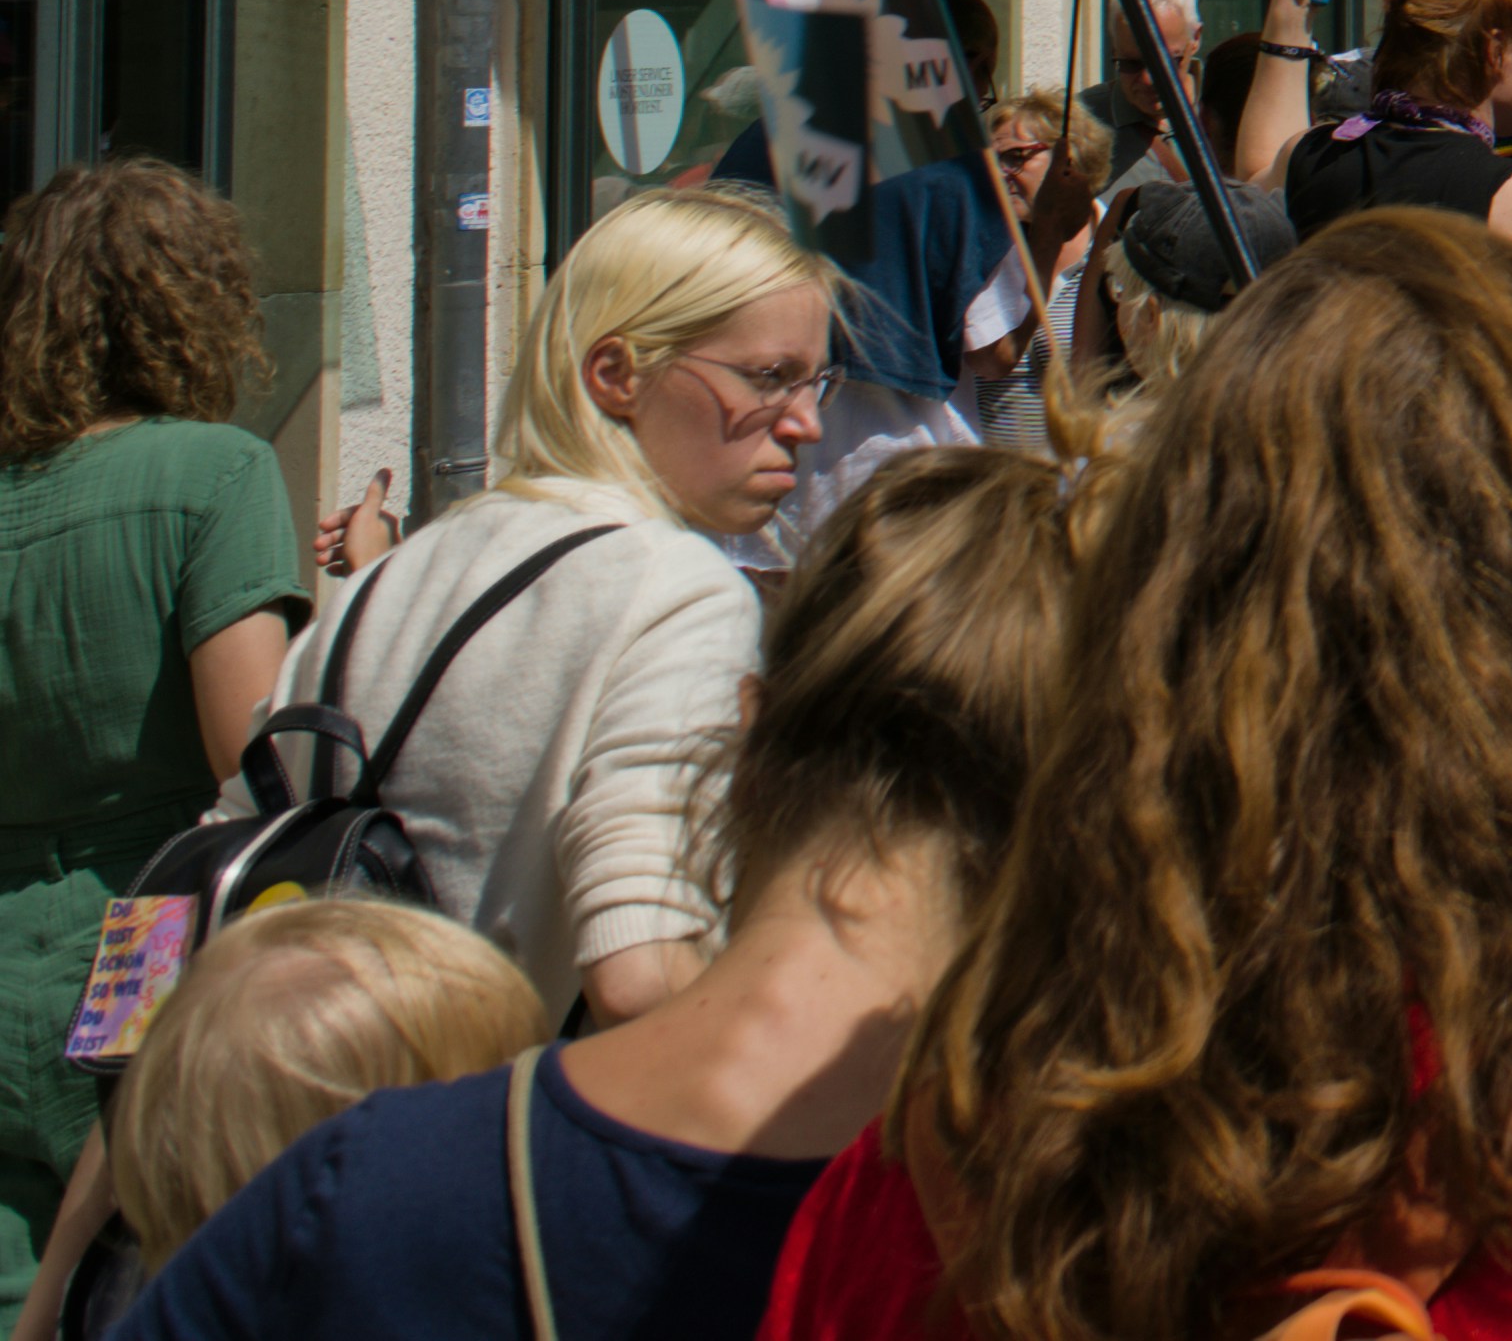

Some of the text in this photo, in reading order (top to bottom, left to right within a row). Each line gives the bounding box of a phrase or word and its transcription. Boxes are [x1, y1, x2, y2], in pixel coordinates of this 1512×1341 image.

[109, 900, 134, 919] DU
[104, 926, 137, 945] BIST
[89, 981, 110, 1001] SO
[113, 978, 144, 998] WIE
[79, 1009, 105, 1027] DU
[69, 1034, 108, 1053] BIST
